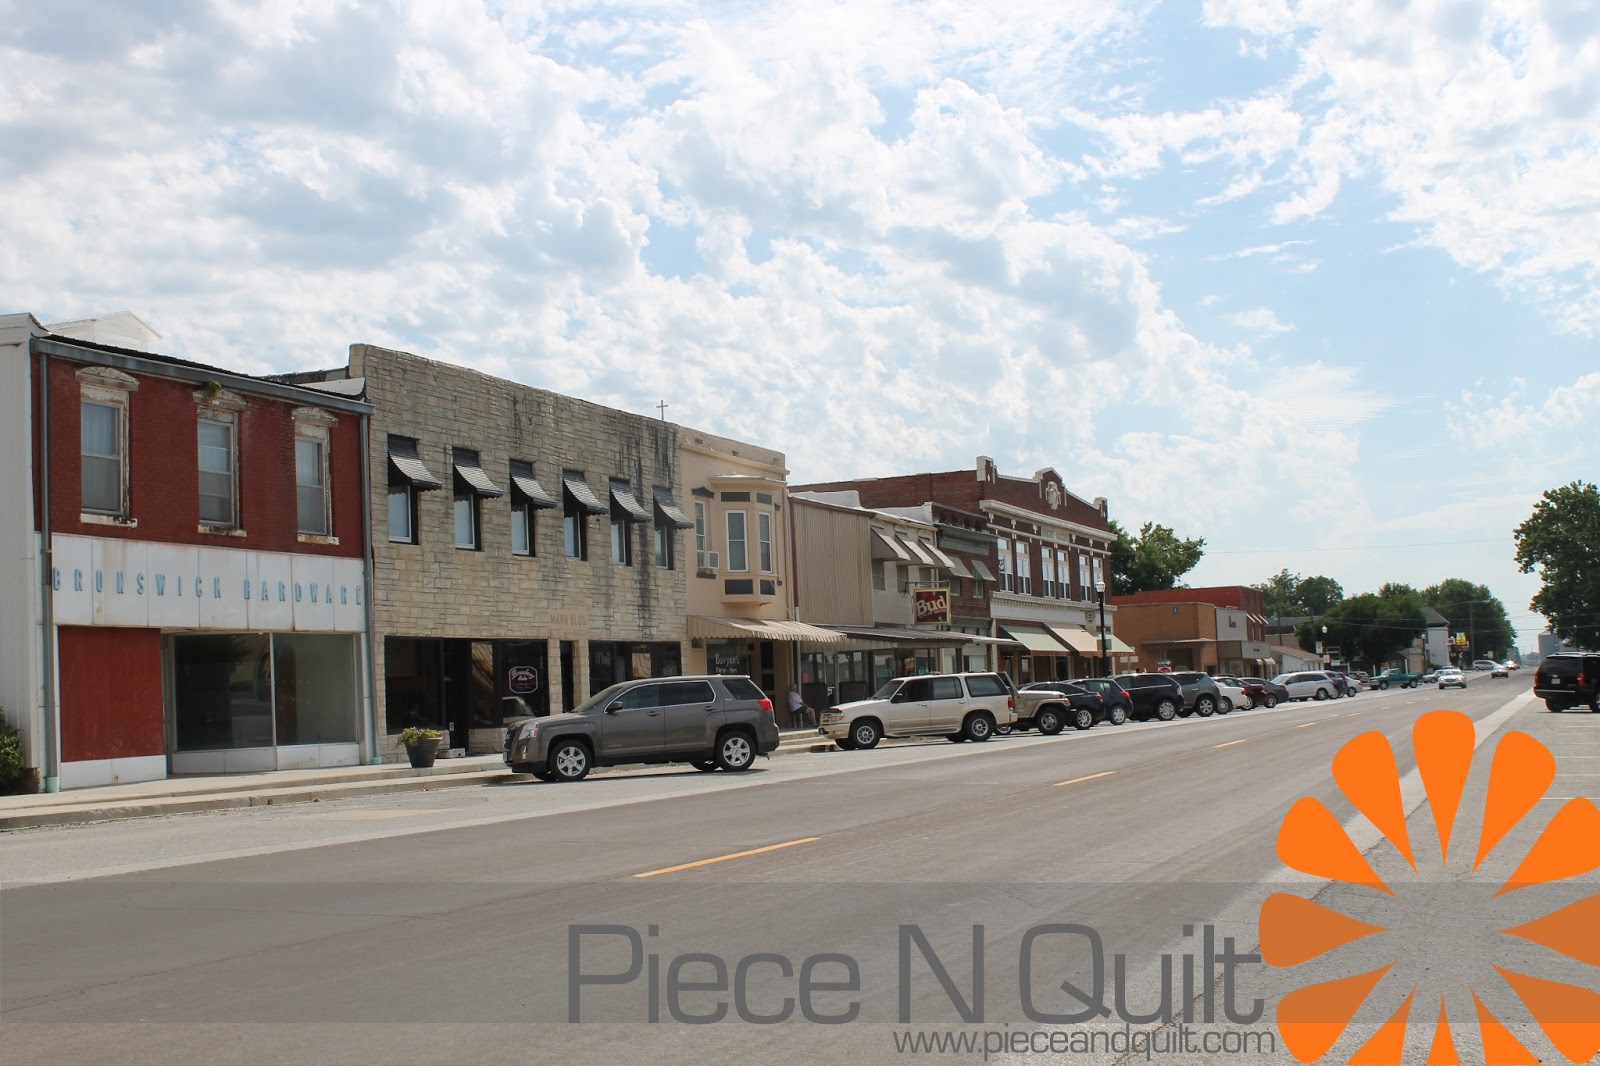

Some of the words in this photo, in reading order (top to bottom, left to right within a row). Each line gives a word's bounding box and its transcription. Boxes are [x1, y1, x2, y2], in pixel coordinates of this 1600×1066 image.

[53, 567, 222, 598] BRUNSWICK
[243, 579, 362, 605] HARDWARE
[916, 595, 947, 616] Bud
